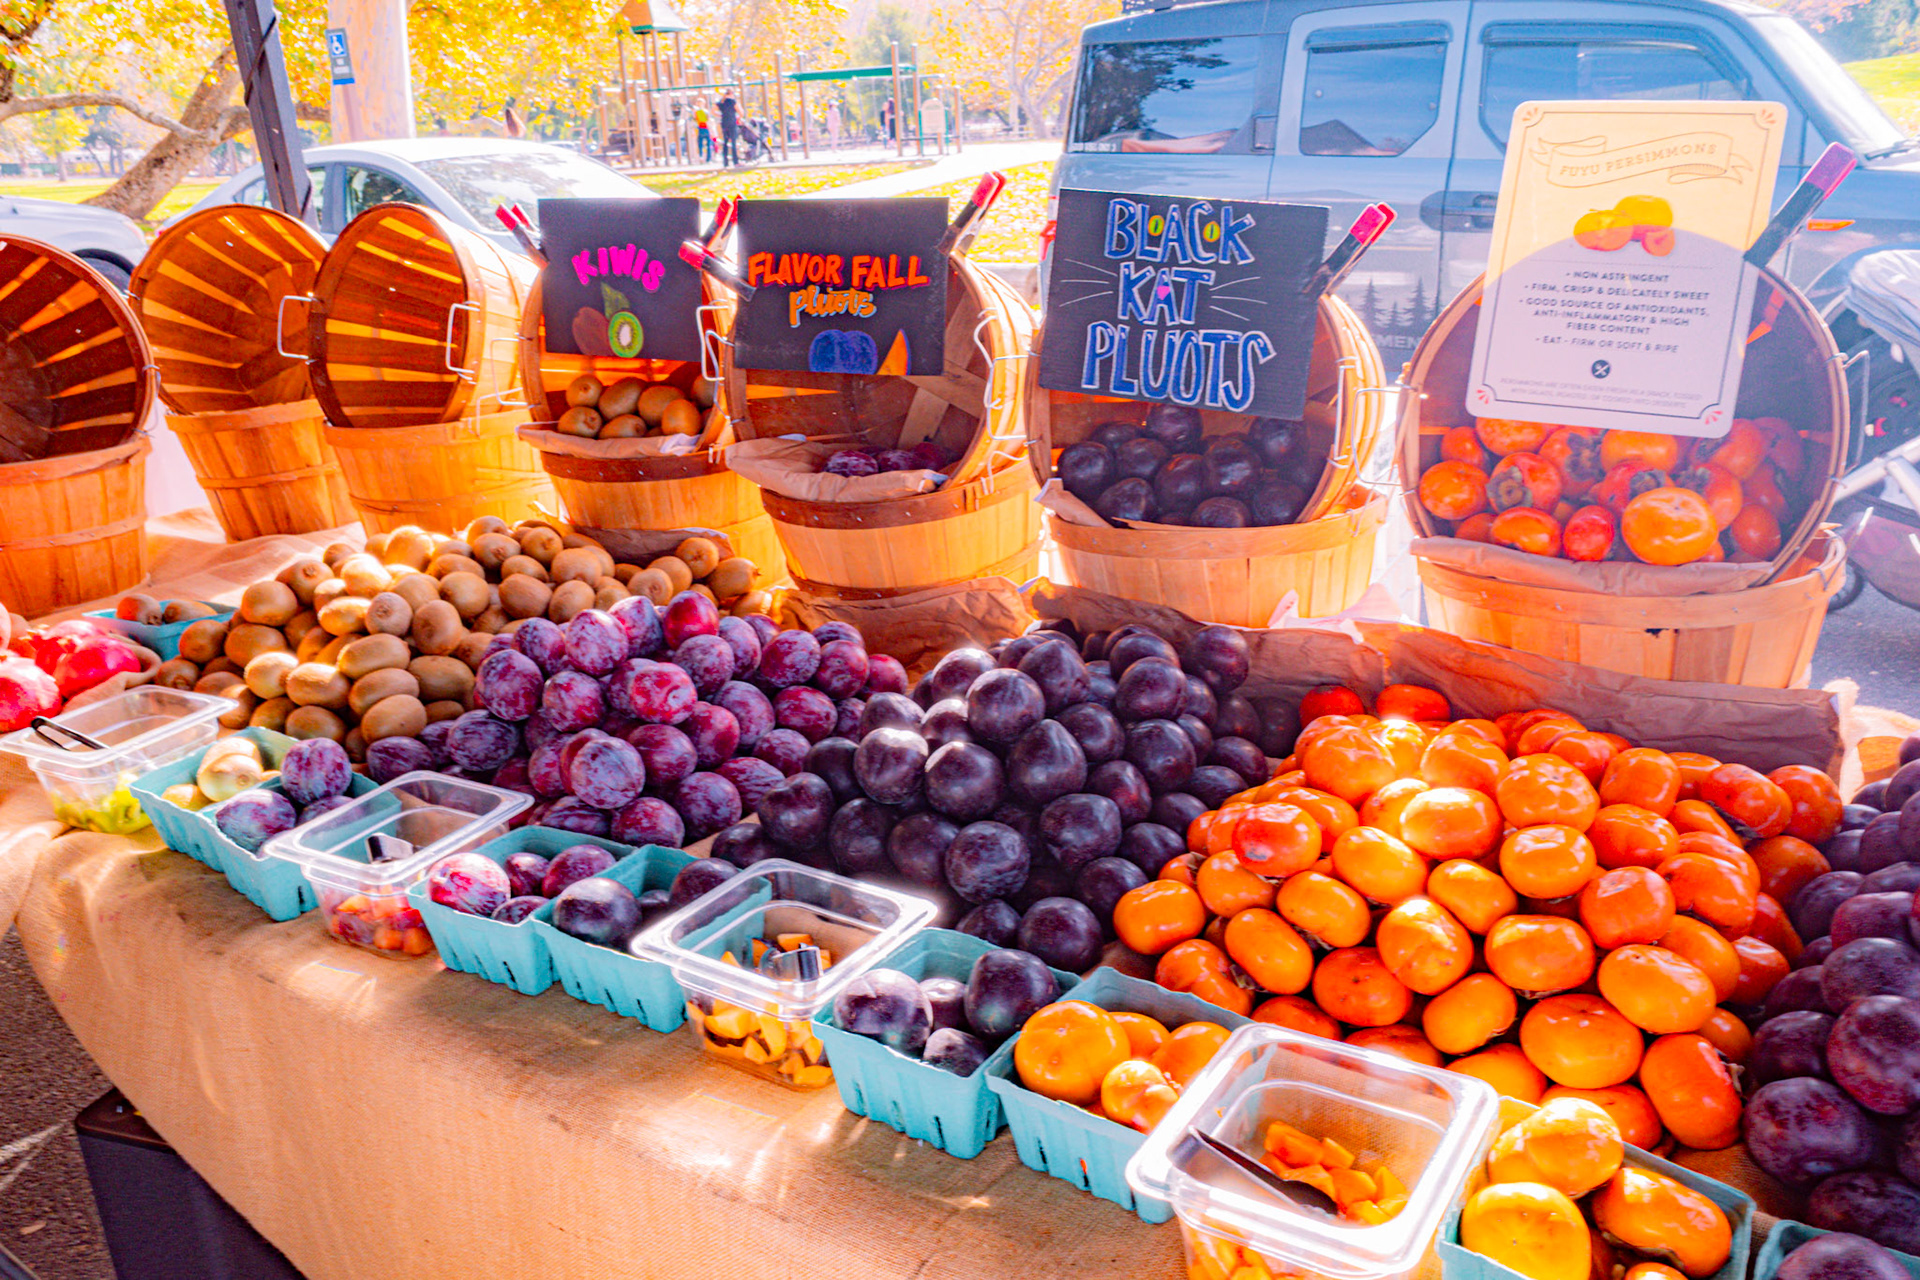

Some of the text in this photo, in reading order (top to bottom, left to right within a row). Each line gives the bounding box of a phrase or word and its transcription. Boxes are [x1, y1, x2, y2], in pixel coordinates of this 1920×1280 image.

[1559, 143, 1717, 177] FUYU PERSIMMONS
[1104, 197, 1257, 265] BLACK
[571, 243, 665, 293] KIWIS
[748, 251, 930, 289] FLAVOR FALL
[1573, 271, 1669, 283] NON ASTRINGENT
[789, 285, 878, 328] pluots
[1117, 261, 1216, 326] KAT
[1525, 297, 1558, 307] GOOD
[1560, 299, 1603, 309] SOURCE
[1606, 302, 1621, 310] OF
[1563, 285, 1594, 294] CRISP
[1607, 287, 1670, 298] DELICATELY
[1673, 290, 1710, 300] SWEET
[1533, 309, 1647, 323] ANTI-INFLAMMATORY
[1660, 317, 1690, 327] HIGH
[1566, 322, 1651, 335] FIBER CONTENT
[1543, 336, 1562, 344] EAT
[1571, 338, 1596, 347] FIRM
[1599, 340, 1613, 348] OR
[1616, 341, 1643, 350] SOFT
[1654, 344, 1680, 353] RIPE
[1081, 321, 1277, 412] PLUOTS
